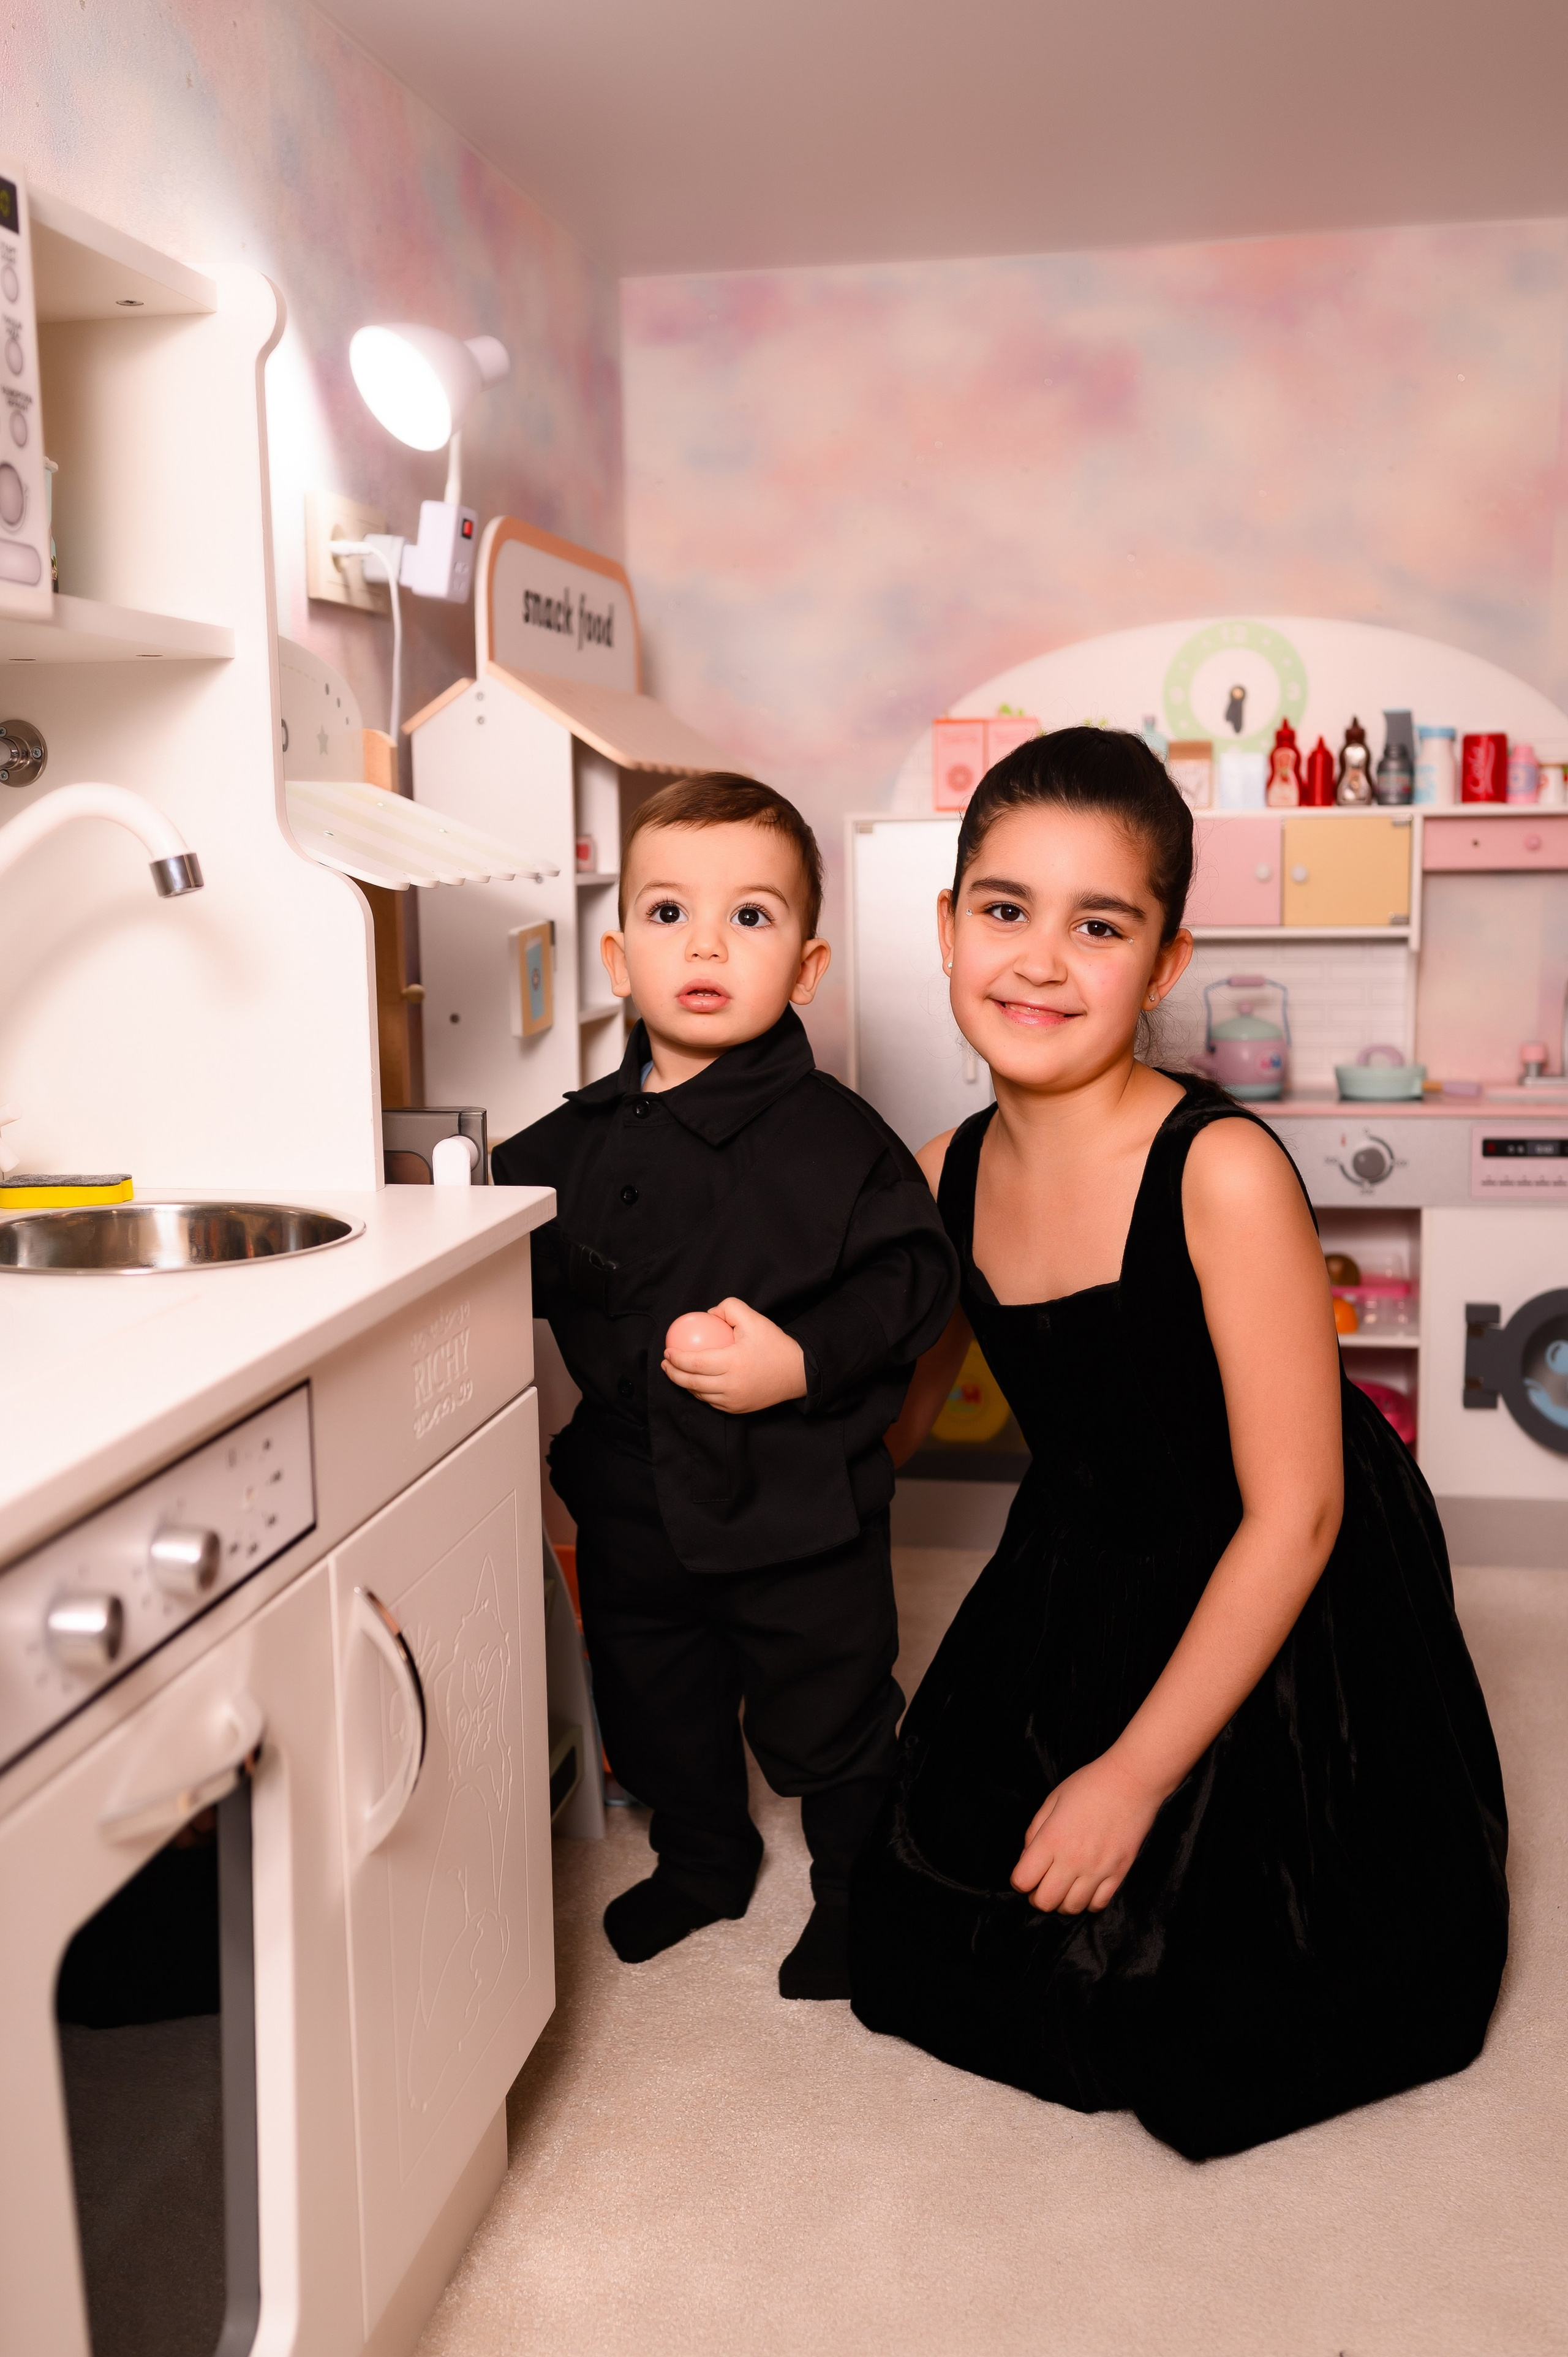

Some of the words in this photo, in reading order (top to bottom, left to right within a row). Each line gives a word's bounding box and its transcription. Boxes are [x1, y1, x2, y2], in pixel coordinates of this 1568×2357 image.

[524, 587, 572, 635] snack
[578, 593, 613, 651] food
[412, 1326, 470, 1409] RICHY
